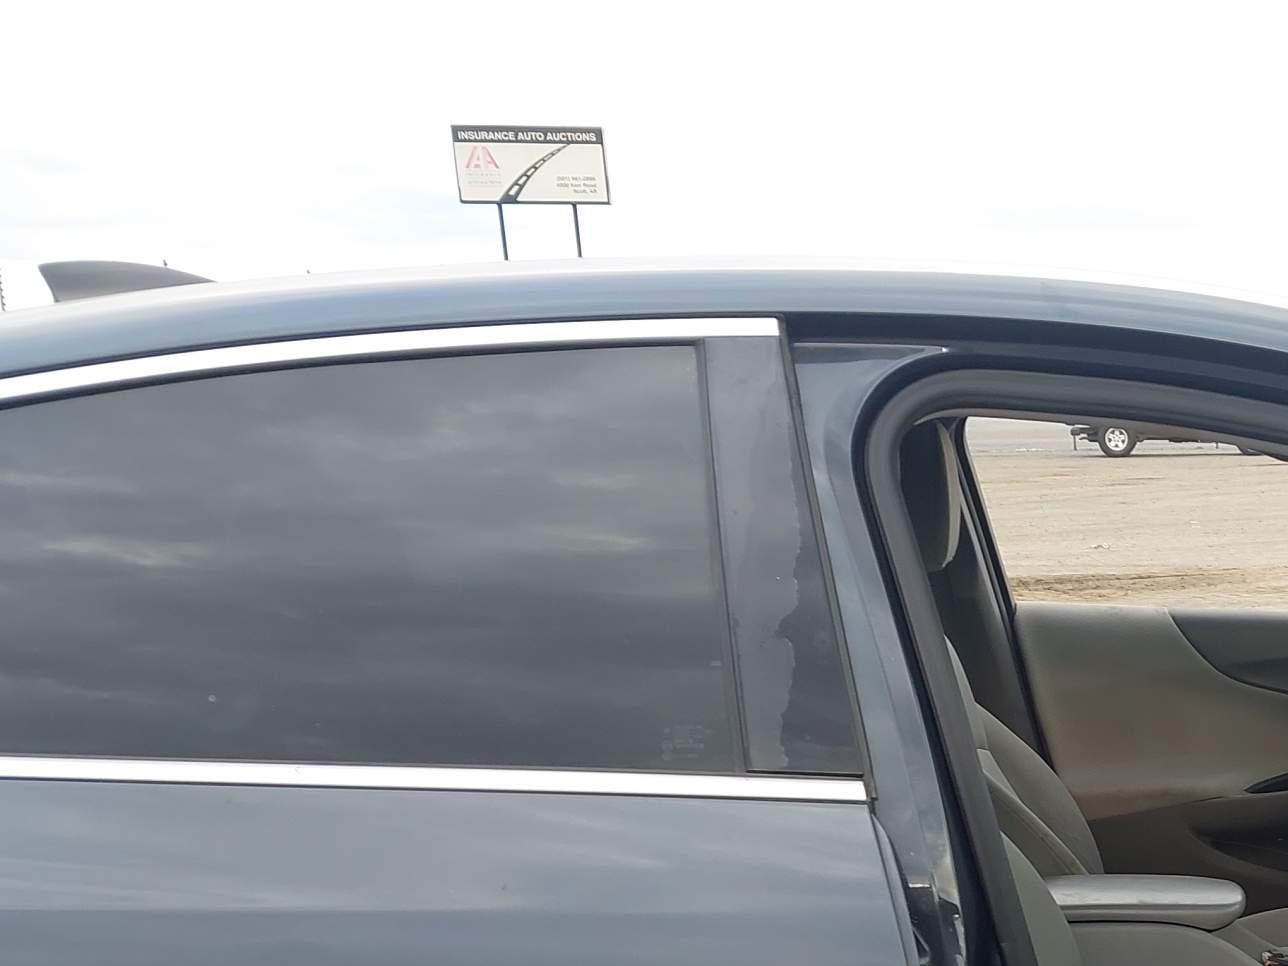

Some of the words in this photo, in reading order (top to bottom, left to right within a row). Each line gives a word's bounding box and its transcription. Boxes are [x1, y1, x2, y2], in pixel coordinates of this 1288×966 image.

[457, 130, 516, 140] INSURANCE
[517, 131, 545, 141] AUTO
[546, 132, 597, 142] AUCTIONS
